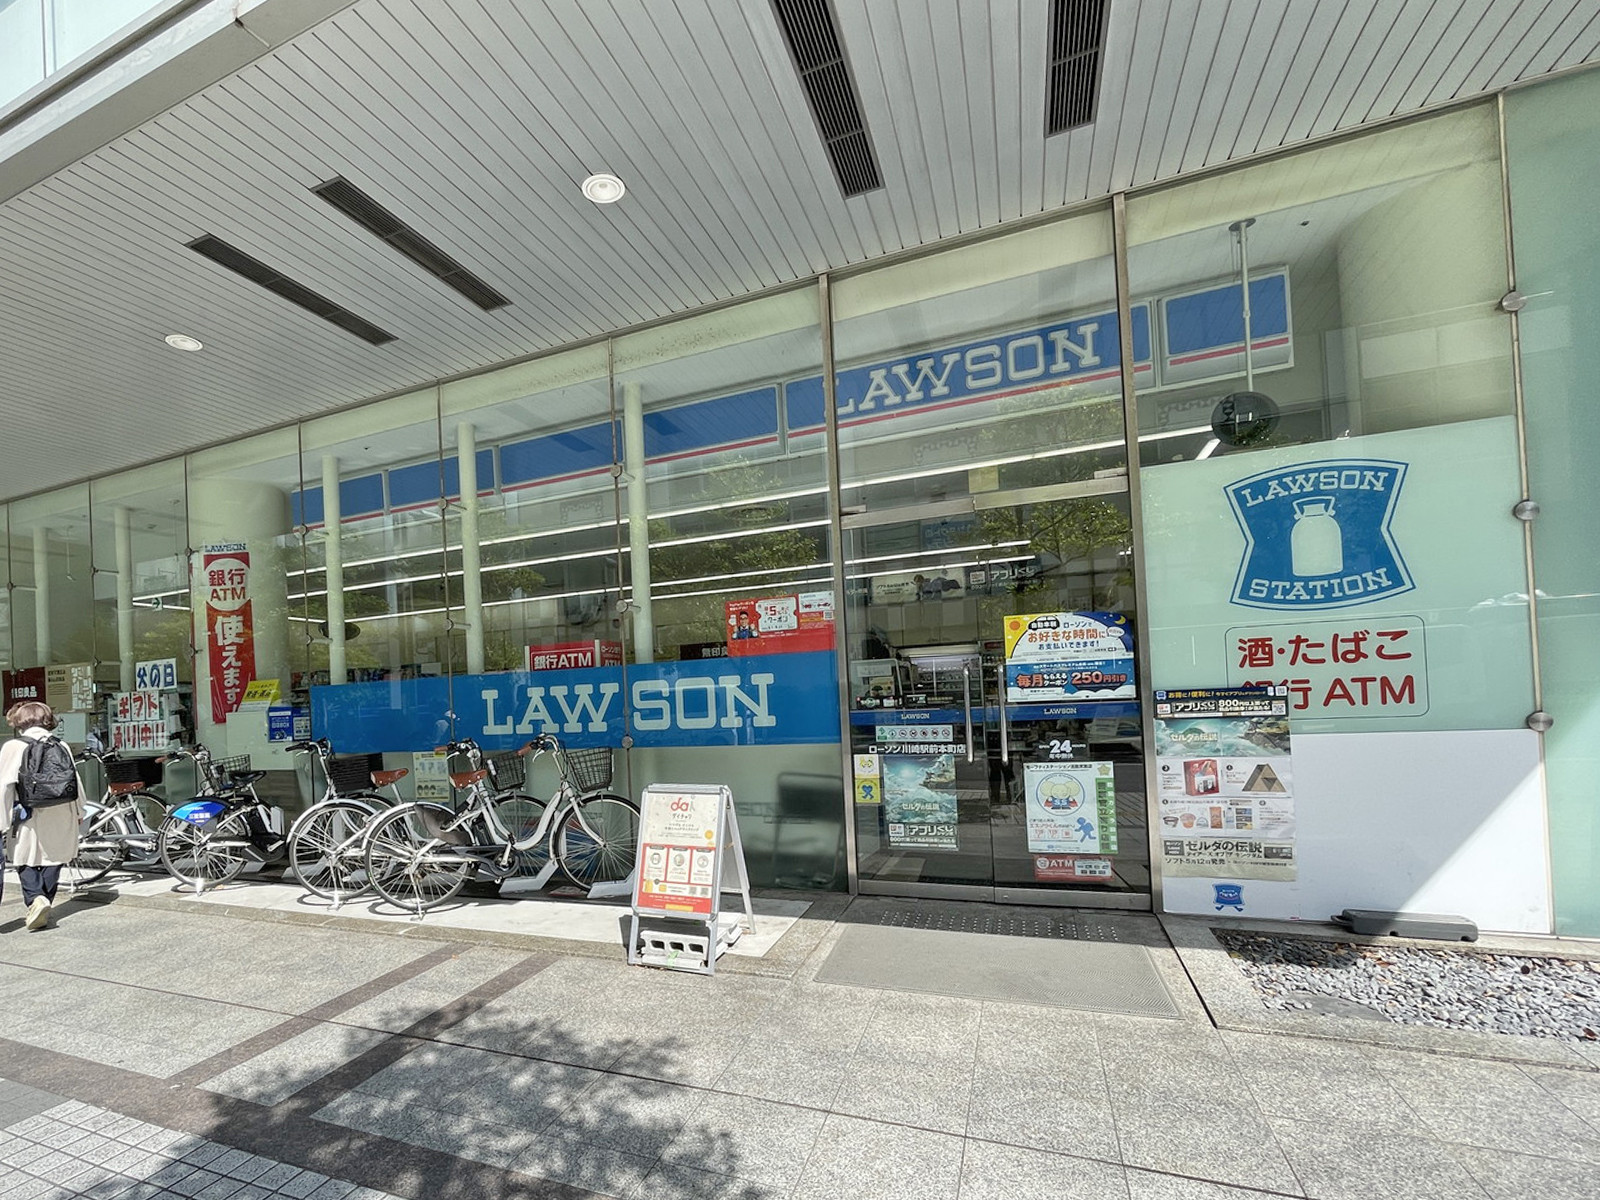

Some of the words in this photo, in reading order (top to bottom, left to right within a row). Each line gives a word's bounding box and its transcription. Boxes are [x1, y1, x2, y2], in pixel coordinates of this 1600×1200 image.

[1241, 470, 1389, 507] LAWSON
[208, 568, 246, 587] 銀行
[1249, 567, 1392, 601] STATION
[210, 586, 246, 602] ATM
[1027, 628, 1106, 643] お好きな時間に
[1238, 629, 1412, 670] 酒・たばこ
[533, 651, 593, 671] 銀行ATM
[136, 663, 175, 690] 父の日
[1016, 673, 1044, 688] 毎月
[1323, 674, 1416, 708] ATM
[119, 693, 158, 719] ギフト
[481, 672, 778, 736] LAWSON
[1043, 707, 1078, 715] LAWSON
[1049, 740, 1073, 754] 24
[1185, 840, 1263, 854] ゼルダの伝説
[1050, 859, 1073, 868] ATM
